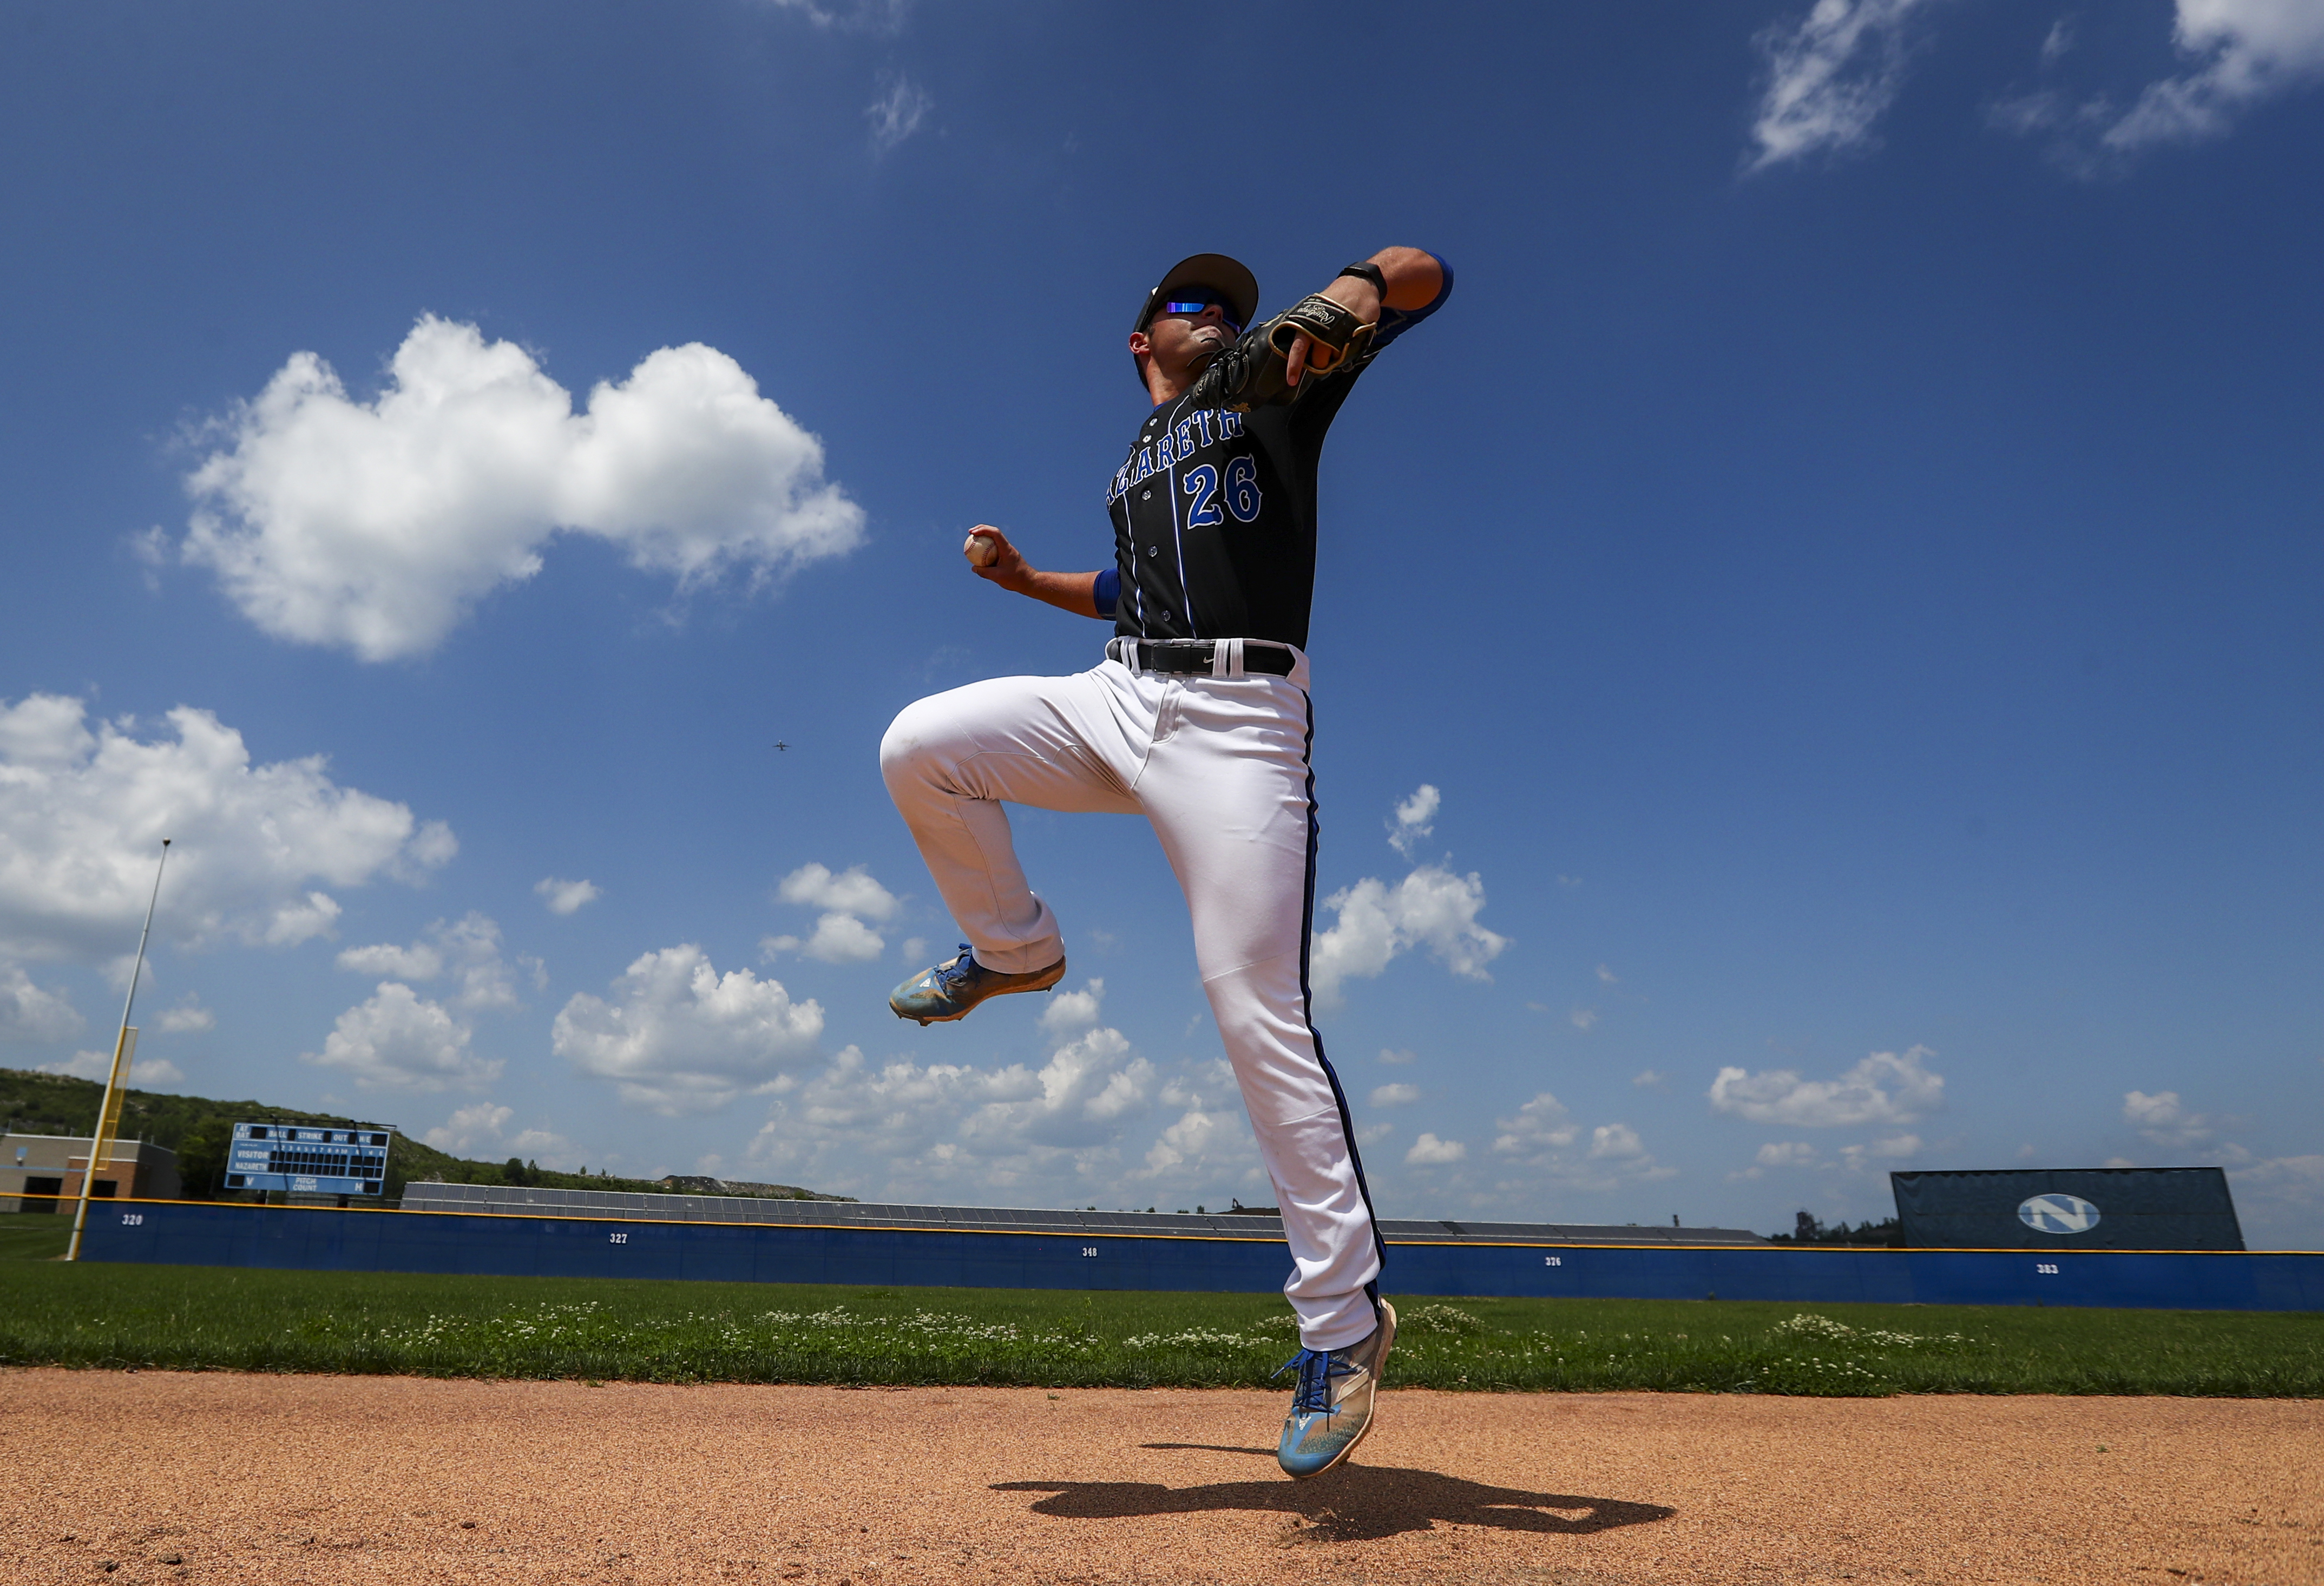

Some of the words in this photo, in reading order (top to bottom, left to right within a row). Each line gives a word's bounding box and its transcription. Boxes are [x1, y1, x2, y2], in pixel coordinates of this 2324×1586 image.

[1106, 408, 1244, 511] AZARETH
[1183, 453, 1263, 530] 26
[268, 1130, 287, 1138] BALL
[298, 1132, 323, 1141] STRIKE
[237, 1150, 269, 1159] VISITOR
[235, 1162, 267, 1171] NAZARETH
[246, 1177, 254, 1186] V
[354, 1183, 363, 1191] H
[2025, 1197, 2089, 1230] N
[122, 1214, 143, 1225] 320
[609, 1233, 627, 1243] 327
[1082, 1247, 1097, 1257] 348
[1545, 1257, 1561, 1266] 376
